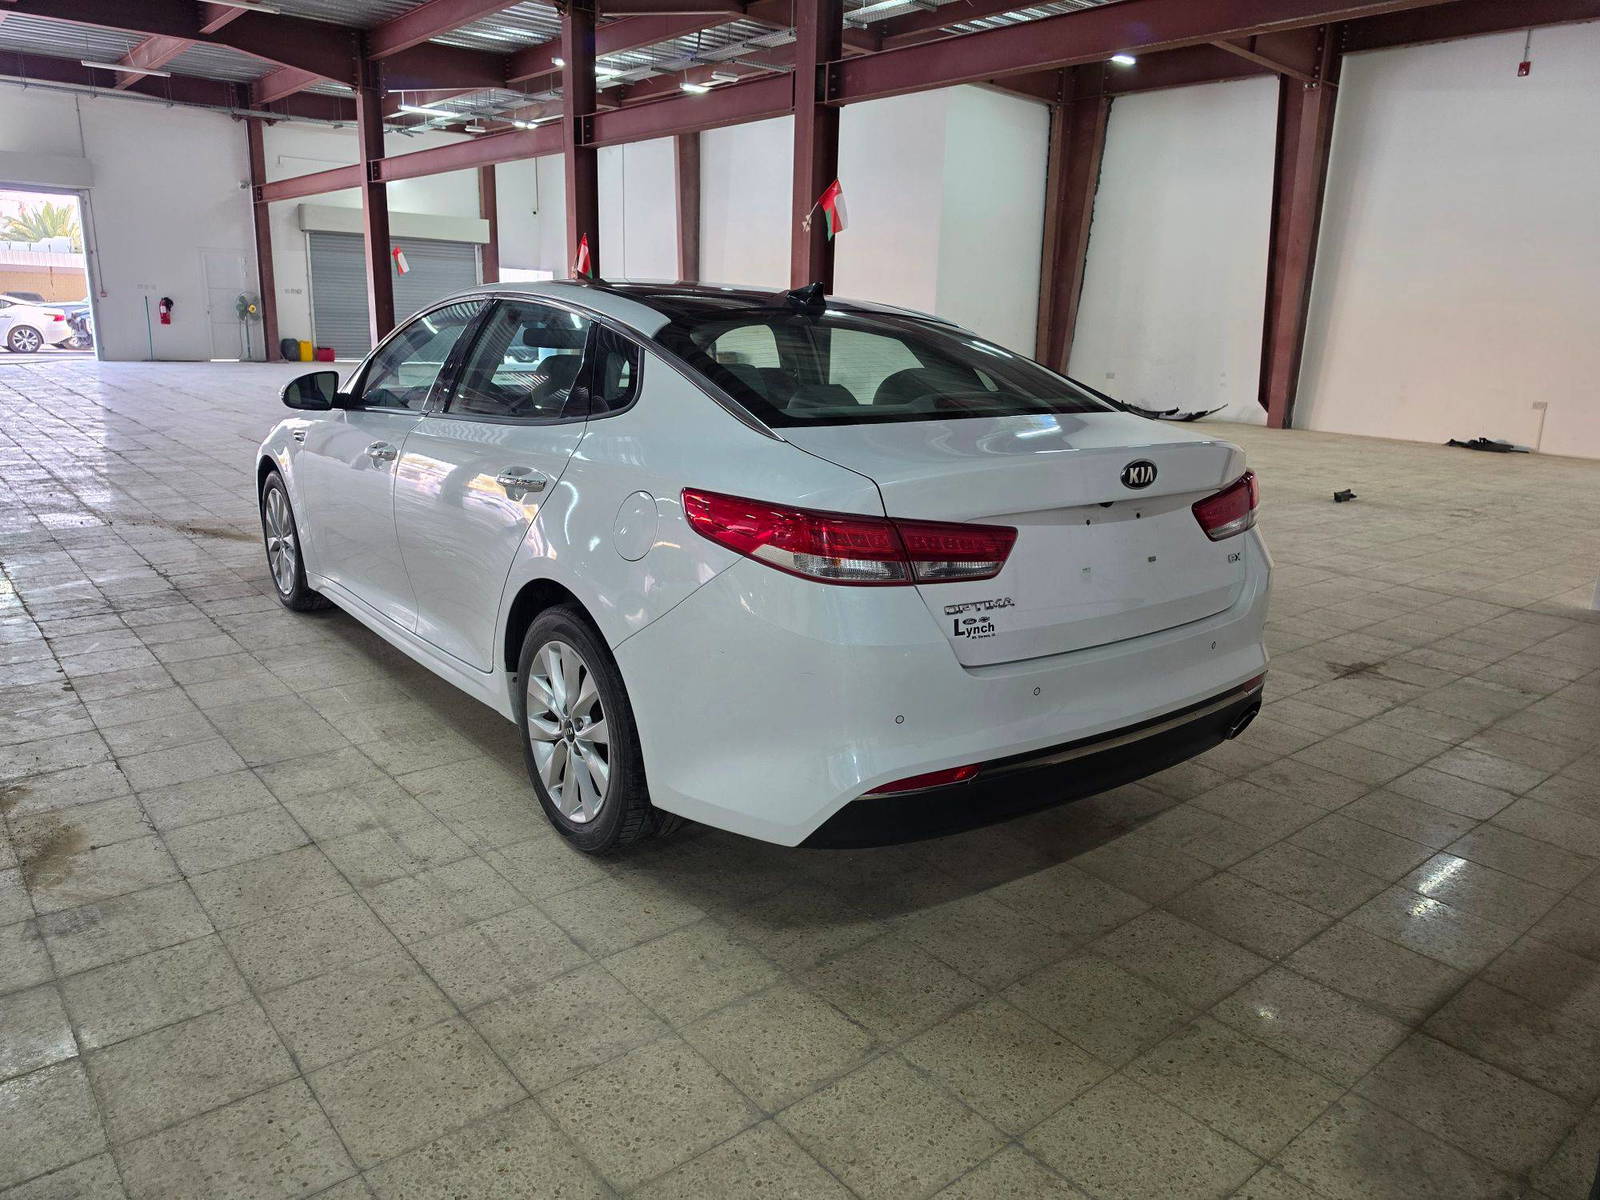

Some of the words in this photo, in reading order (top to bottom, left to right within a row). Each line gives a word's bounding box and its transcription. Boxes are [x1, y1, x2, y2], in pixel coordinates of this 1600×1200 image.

[1129, 466, 1154, 484] KIA
[944, 597, 1015, 615] OPTIMA
[954, 618, 995, 638] Lynch
